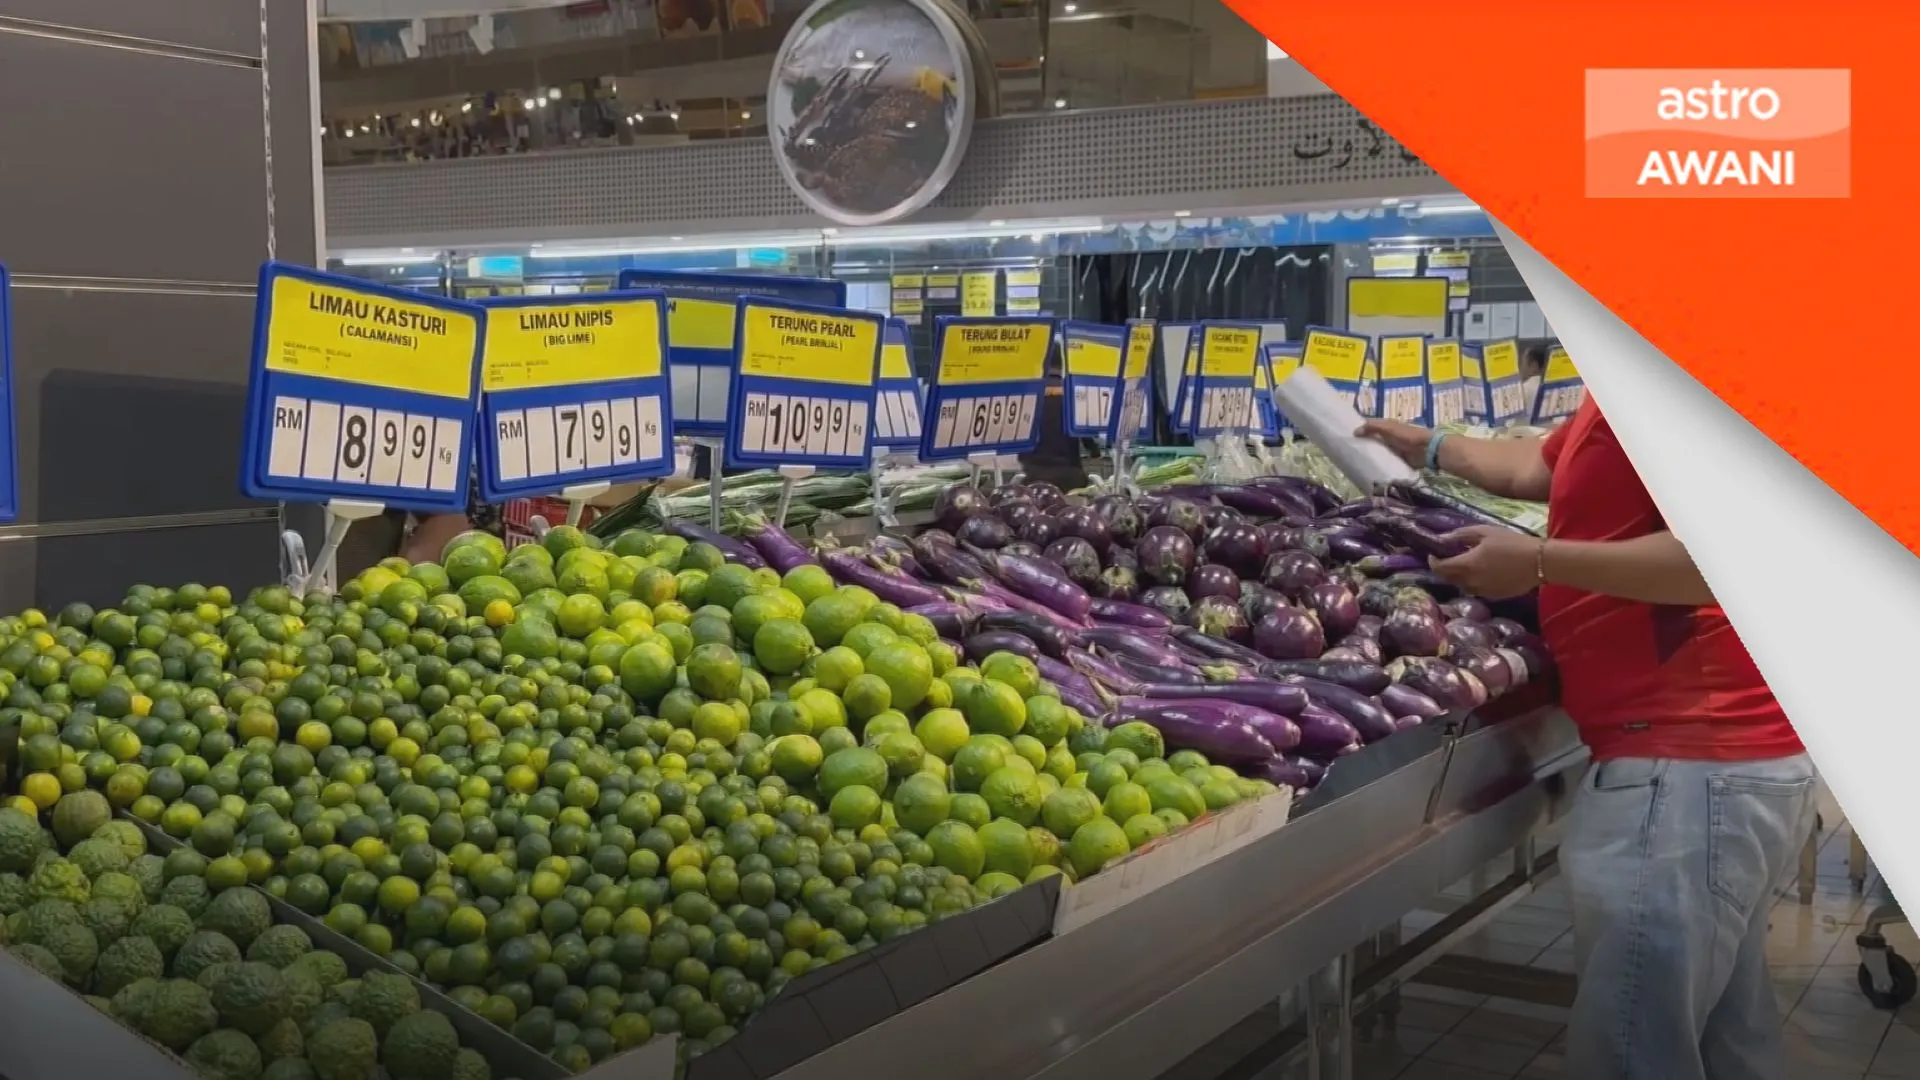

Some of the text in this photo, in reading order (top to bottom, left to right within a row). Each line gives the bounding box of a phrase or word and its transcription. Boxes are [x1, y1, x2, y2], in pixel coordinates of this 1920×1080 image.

[309, 291, 447, 336] LIMAU KASTURI
[520, 309, 614, 330] LIMAU NIPIS
[340, 323, 418, 350] (CALAMANSI)
[769, 314, 856, 338] TERUNG PEARL
[961, 328, 1032, 341] TERUNG BULAT
[543, 331, 596, 348] (BIG LIME)
[748, 401, 765, 417] RM
[276, 407, 303, 430] RM
[439, 447, 452, 465] Kg
[499, 420, 522, 440] RM
[645, 421, 657, 436] Kg
